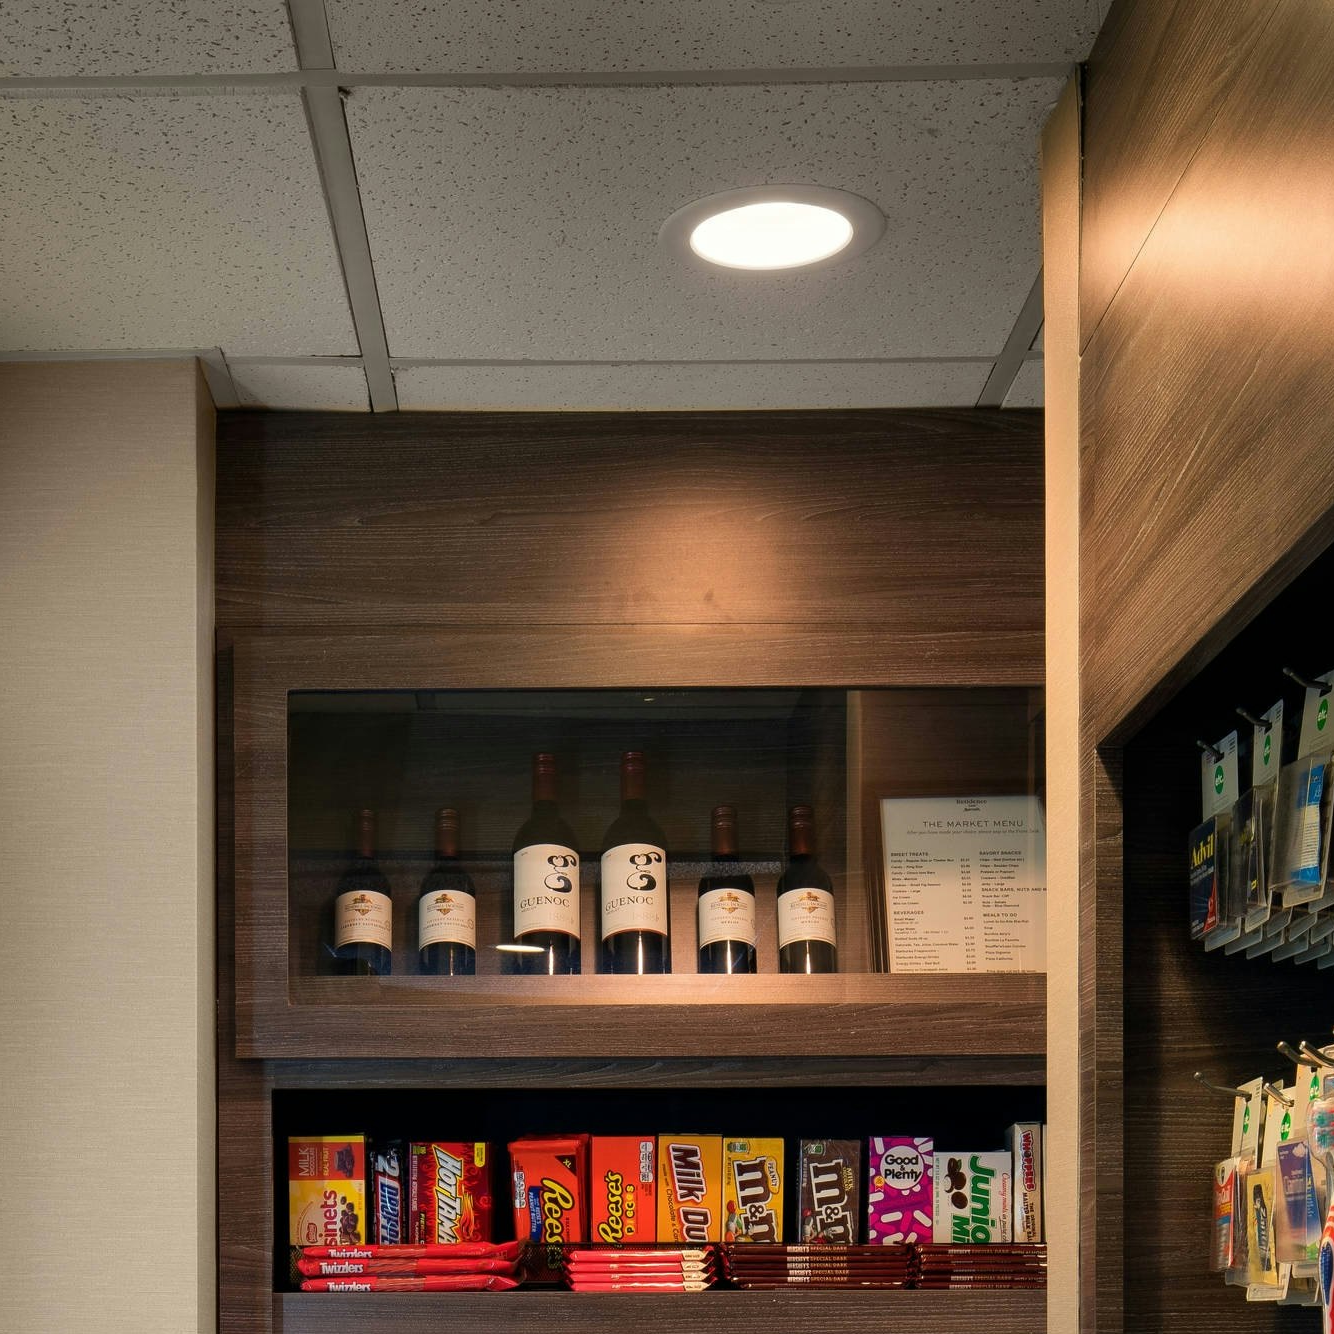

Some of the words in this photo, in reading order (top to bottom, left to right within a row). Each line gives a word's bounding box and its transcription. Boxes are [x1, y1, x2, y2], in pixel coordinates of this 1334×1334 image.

[947, 820, 989, 828] MARKET
[993, 819, 1024, 828] MENU
[1191, 833, 1214, 868] Advil
[520, 895, 571, 910] GUENOC
[605, 896, 654, 912] GUENOC
[299, 1147, 309, 1177] MILK
[563, 1158, 573, 1169] XL
[884, 1154, 919, 1166] Good
[1021, 1130, 1036, 1192] WHOPPERS
[671, 1145, 706, 1202] Milk
[767, 1162, 778, 1188] PEANUT
[884, 1168, 922, 1183] Plenty
[320, 1261, 364, 1274] Twizzlers
